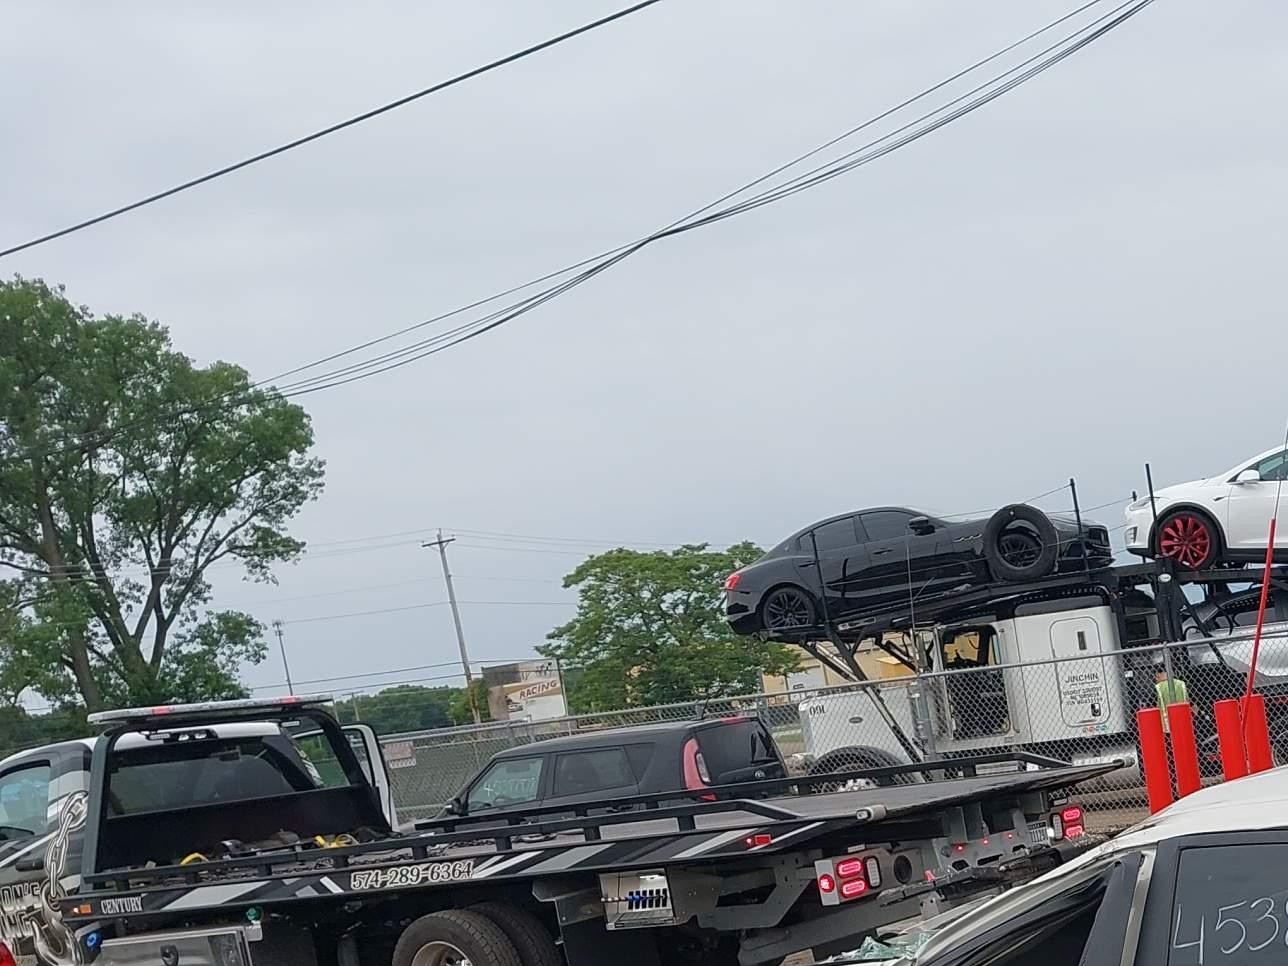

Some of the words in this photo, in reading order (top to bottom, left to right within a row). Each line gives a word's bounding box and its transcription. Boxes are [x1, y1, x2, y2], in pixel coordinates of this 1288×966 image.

[1065, 672, 1099, 683] JINCHIN
[520, 680, 557, 700] RACING
[350, 860, 474, 889] 574-289-6364
[101, 896, 143, 914] CENTURY
